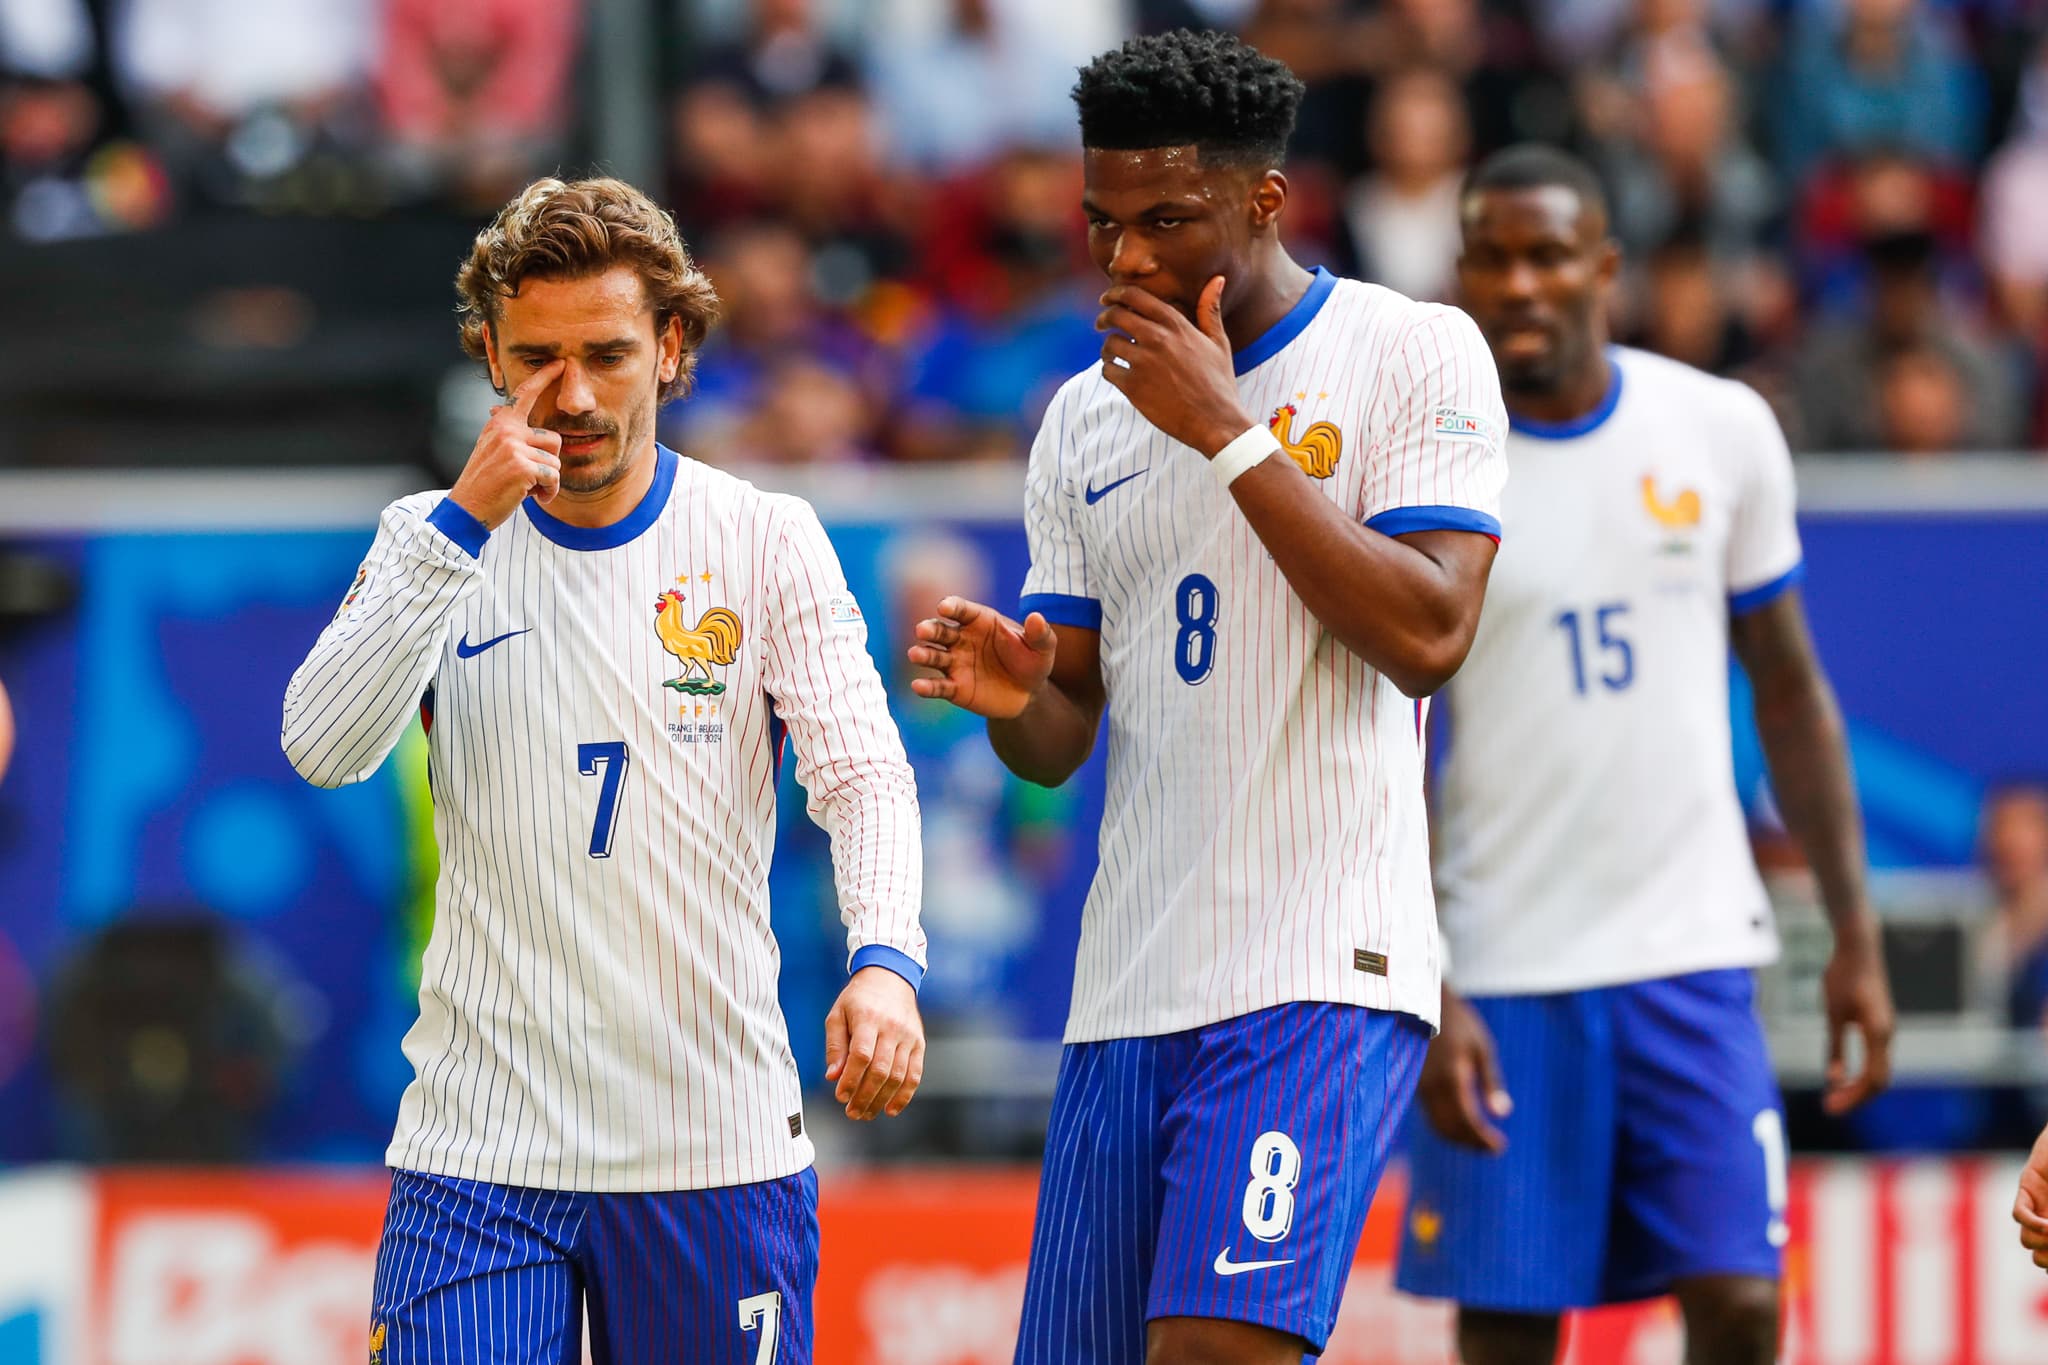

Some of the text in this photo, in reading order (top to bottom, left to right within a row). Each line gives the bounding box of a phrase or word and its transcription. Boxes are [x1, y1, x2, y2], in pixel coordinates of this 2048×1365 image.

[1175, 573, 1219, 686] 8
[1553, 604, 1635, 696] 15
[668, 723, 693, 733] FRANCE
[671, 733, 680, 743] 01
[704, 733, 722, 743] 2024
[577, 741, 630, 859] 7
[1242, 1130, 1302, 1243] 8
[1752, 1108, 1787, 1214] 1
[738, 1290, 782, 1365] 7
